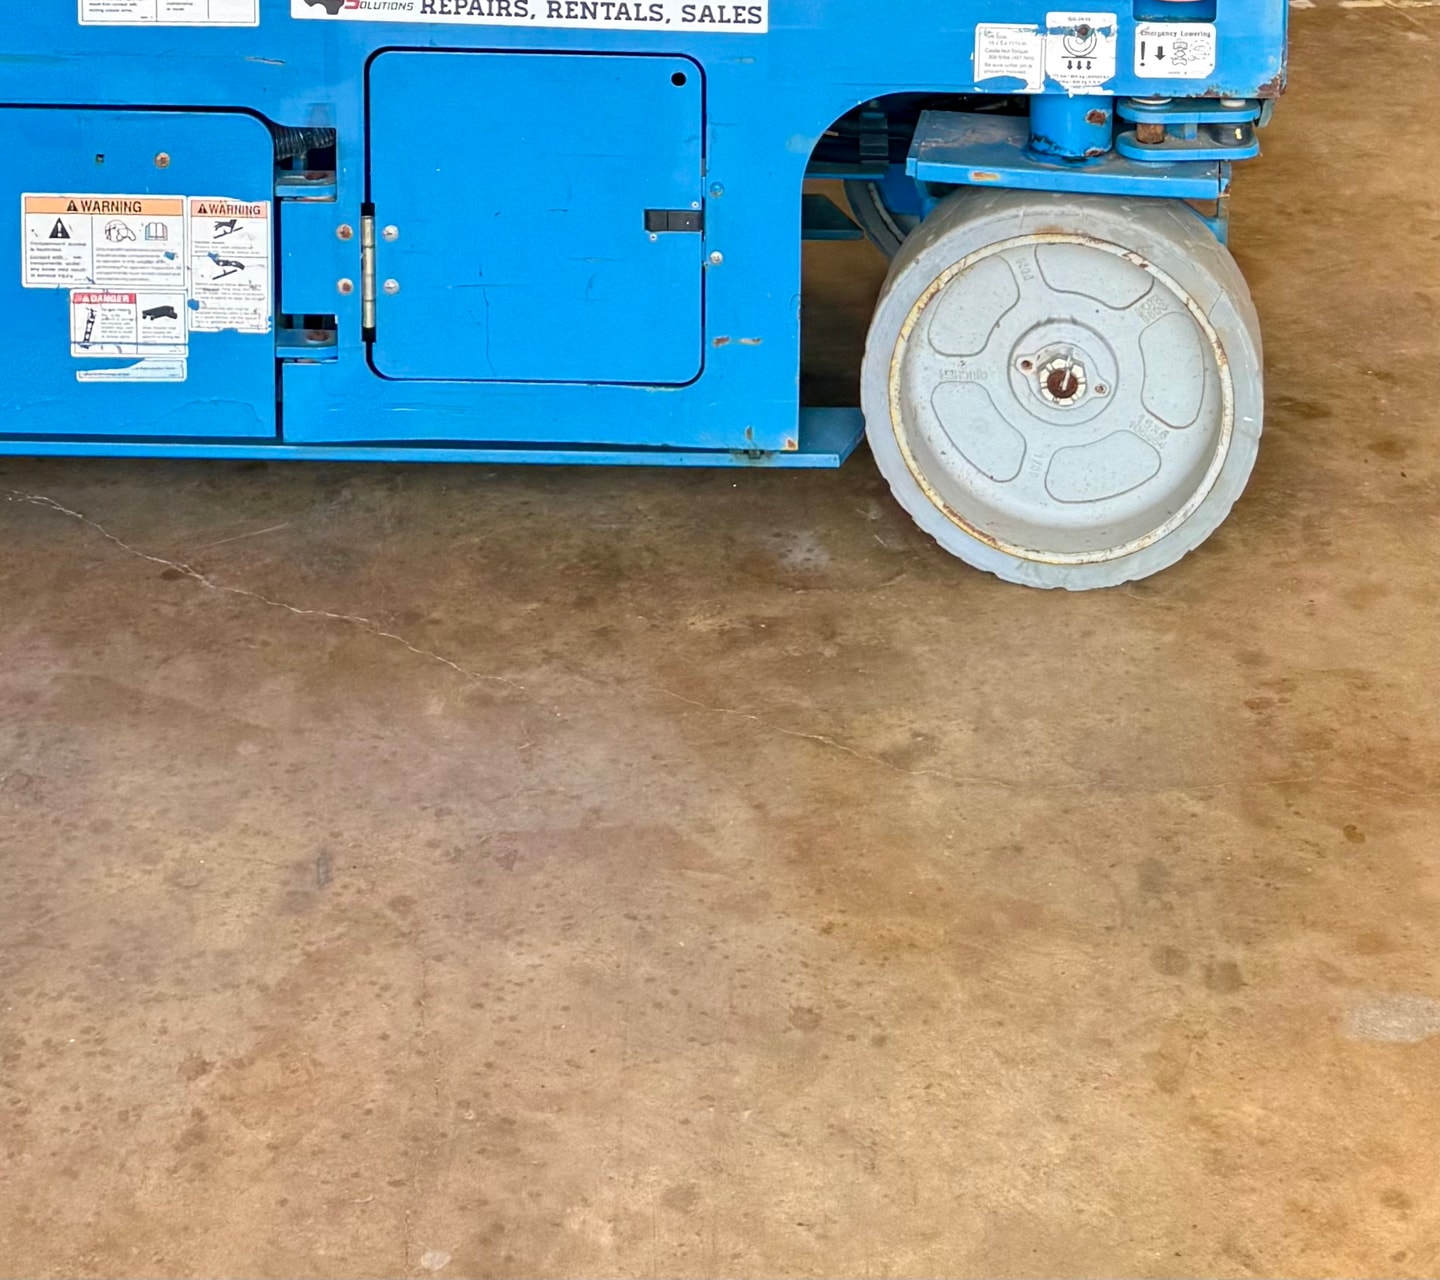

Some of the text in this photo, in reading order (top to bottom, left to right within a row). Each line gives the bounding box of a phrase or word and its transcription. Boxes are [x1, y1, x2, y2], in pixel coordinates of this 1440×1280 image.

[546, 0, 671, 24] RENTALS,
[681, 5, 762, 24] SALES
[81, 200, 142, 213] WARNING
[208, 204, 261, 215] WARNING
[90, 294, 129, 303] DANGER
